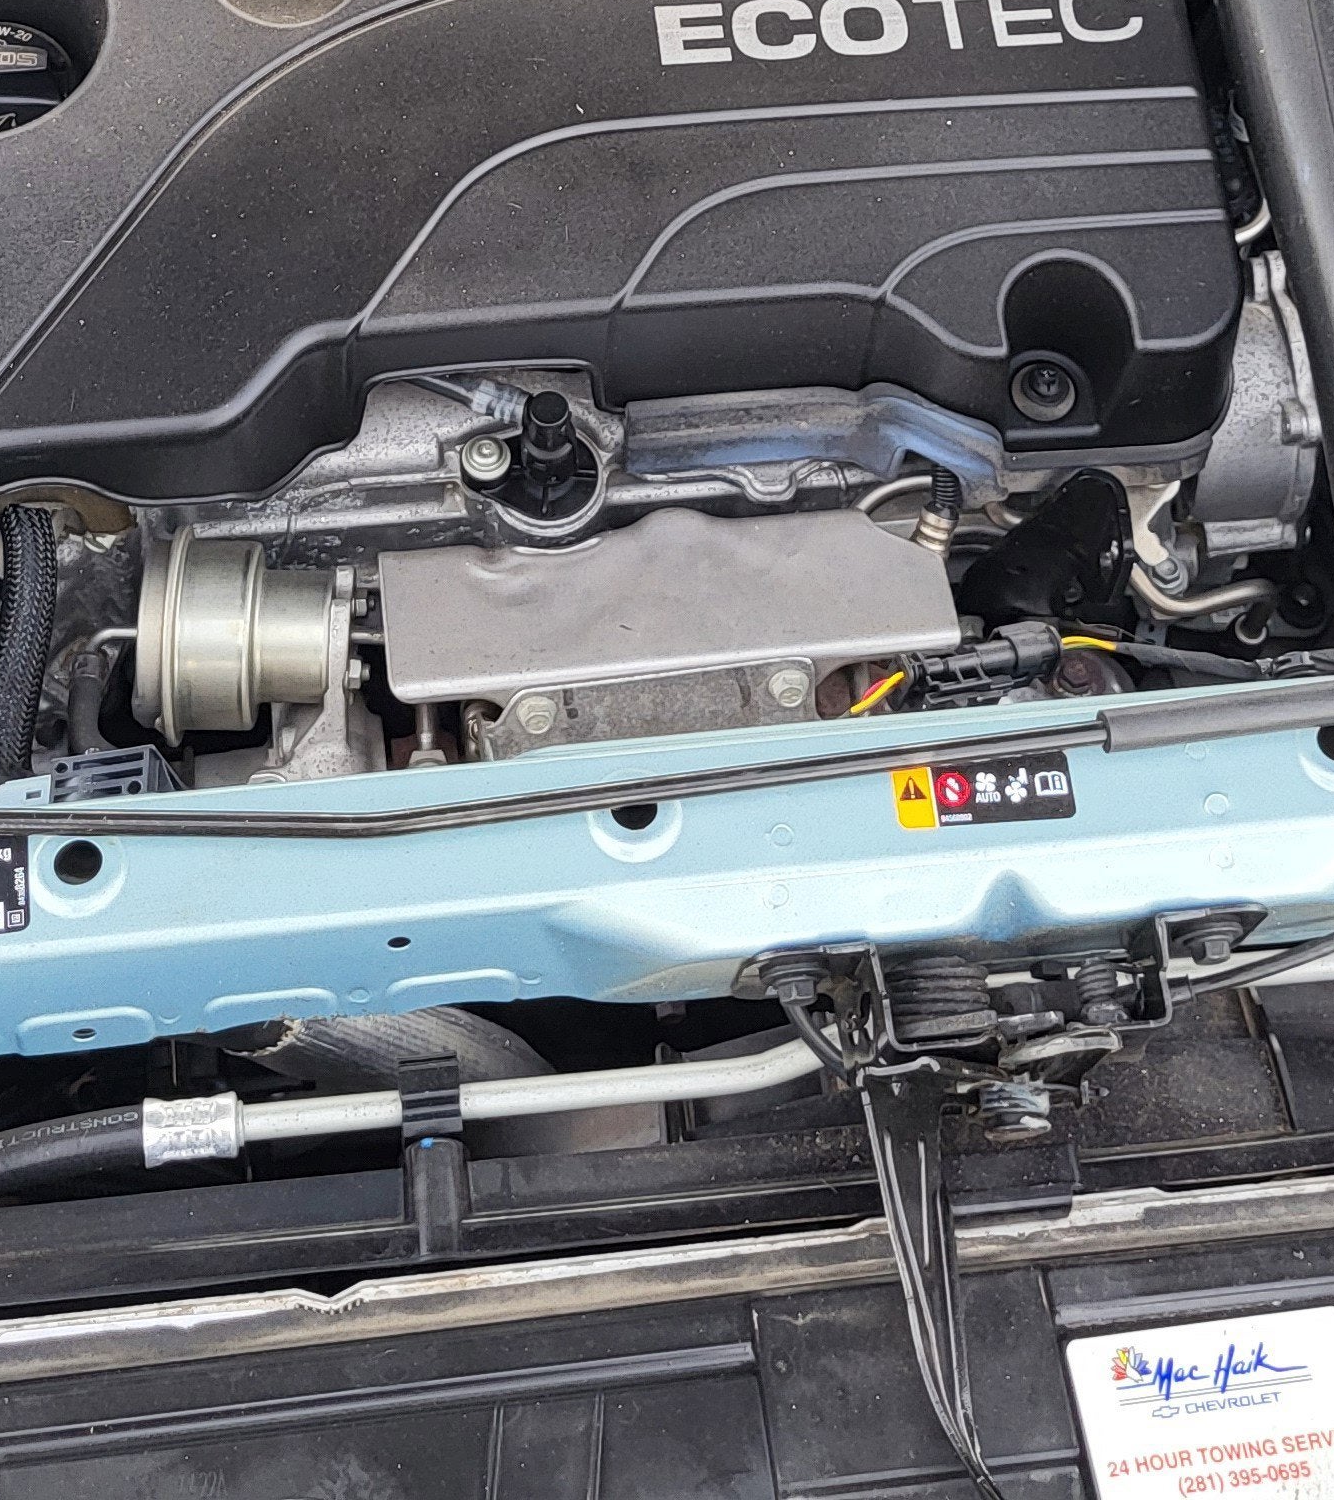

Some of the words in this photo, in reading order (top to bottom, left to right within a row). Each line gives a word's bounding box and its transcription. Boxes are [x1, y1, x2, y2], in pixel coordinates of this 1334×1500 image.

[975, 791, 1002, 804] AUTO
[1152, 1357, 1210, 1401] Mac
[1213, 1342, 1308, 1394] Haik
[1185, 1391, 1282, 1414] CHEVROLET
[1107, 1460, 1130, 1478] 24
[1135, 1450, 1193, 1473] HOUR
[1196, 1438, 1278, 1465] TOWING
[1178, 1471, 1224, 1498] (281)
[1229, 1459, 1312, 1488] 395-0695
